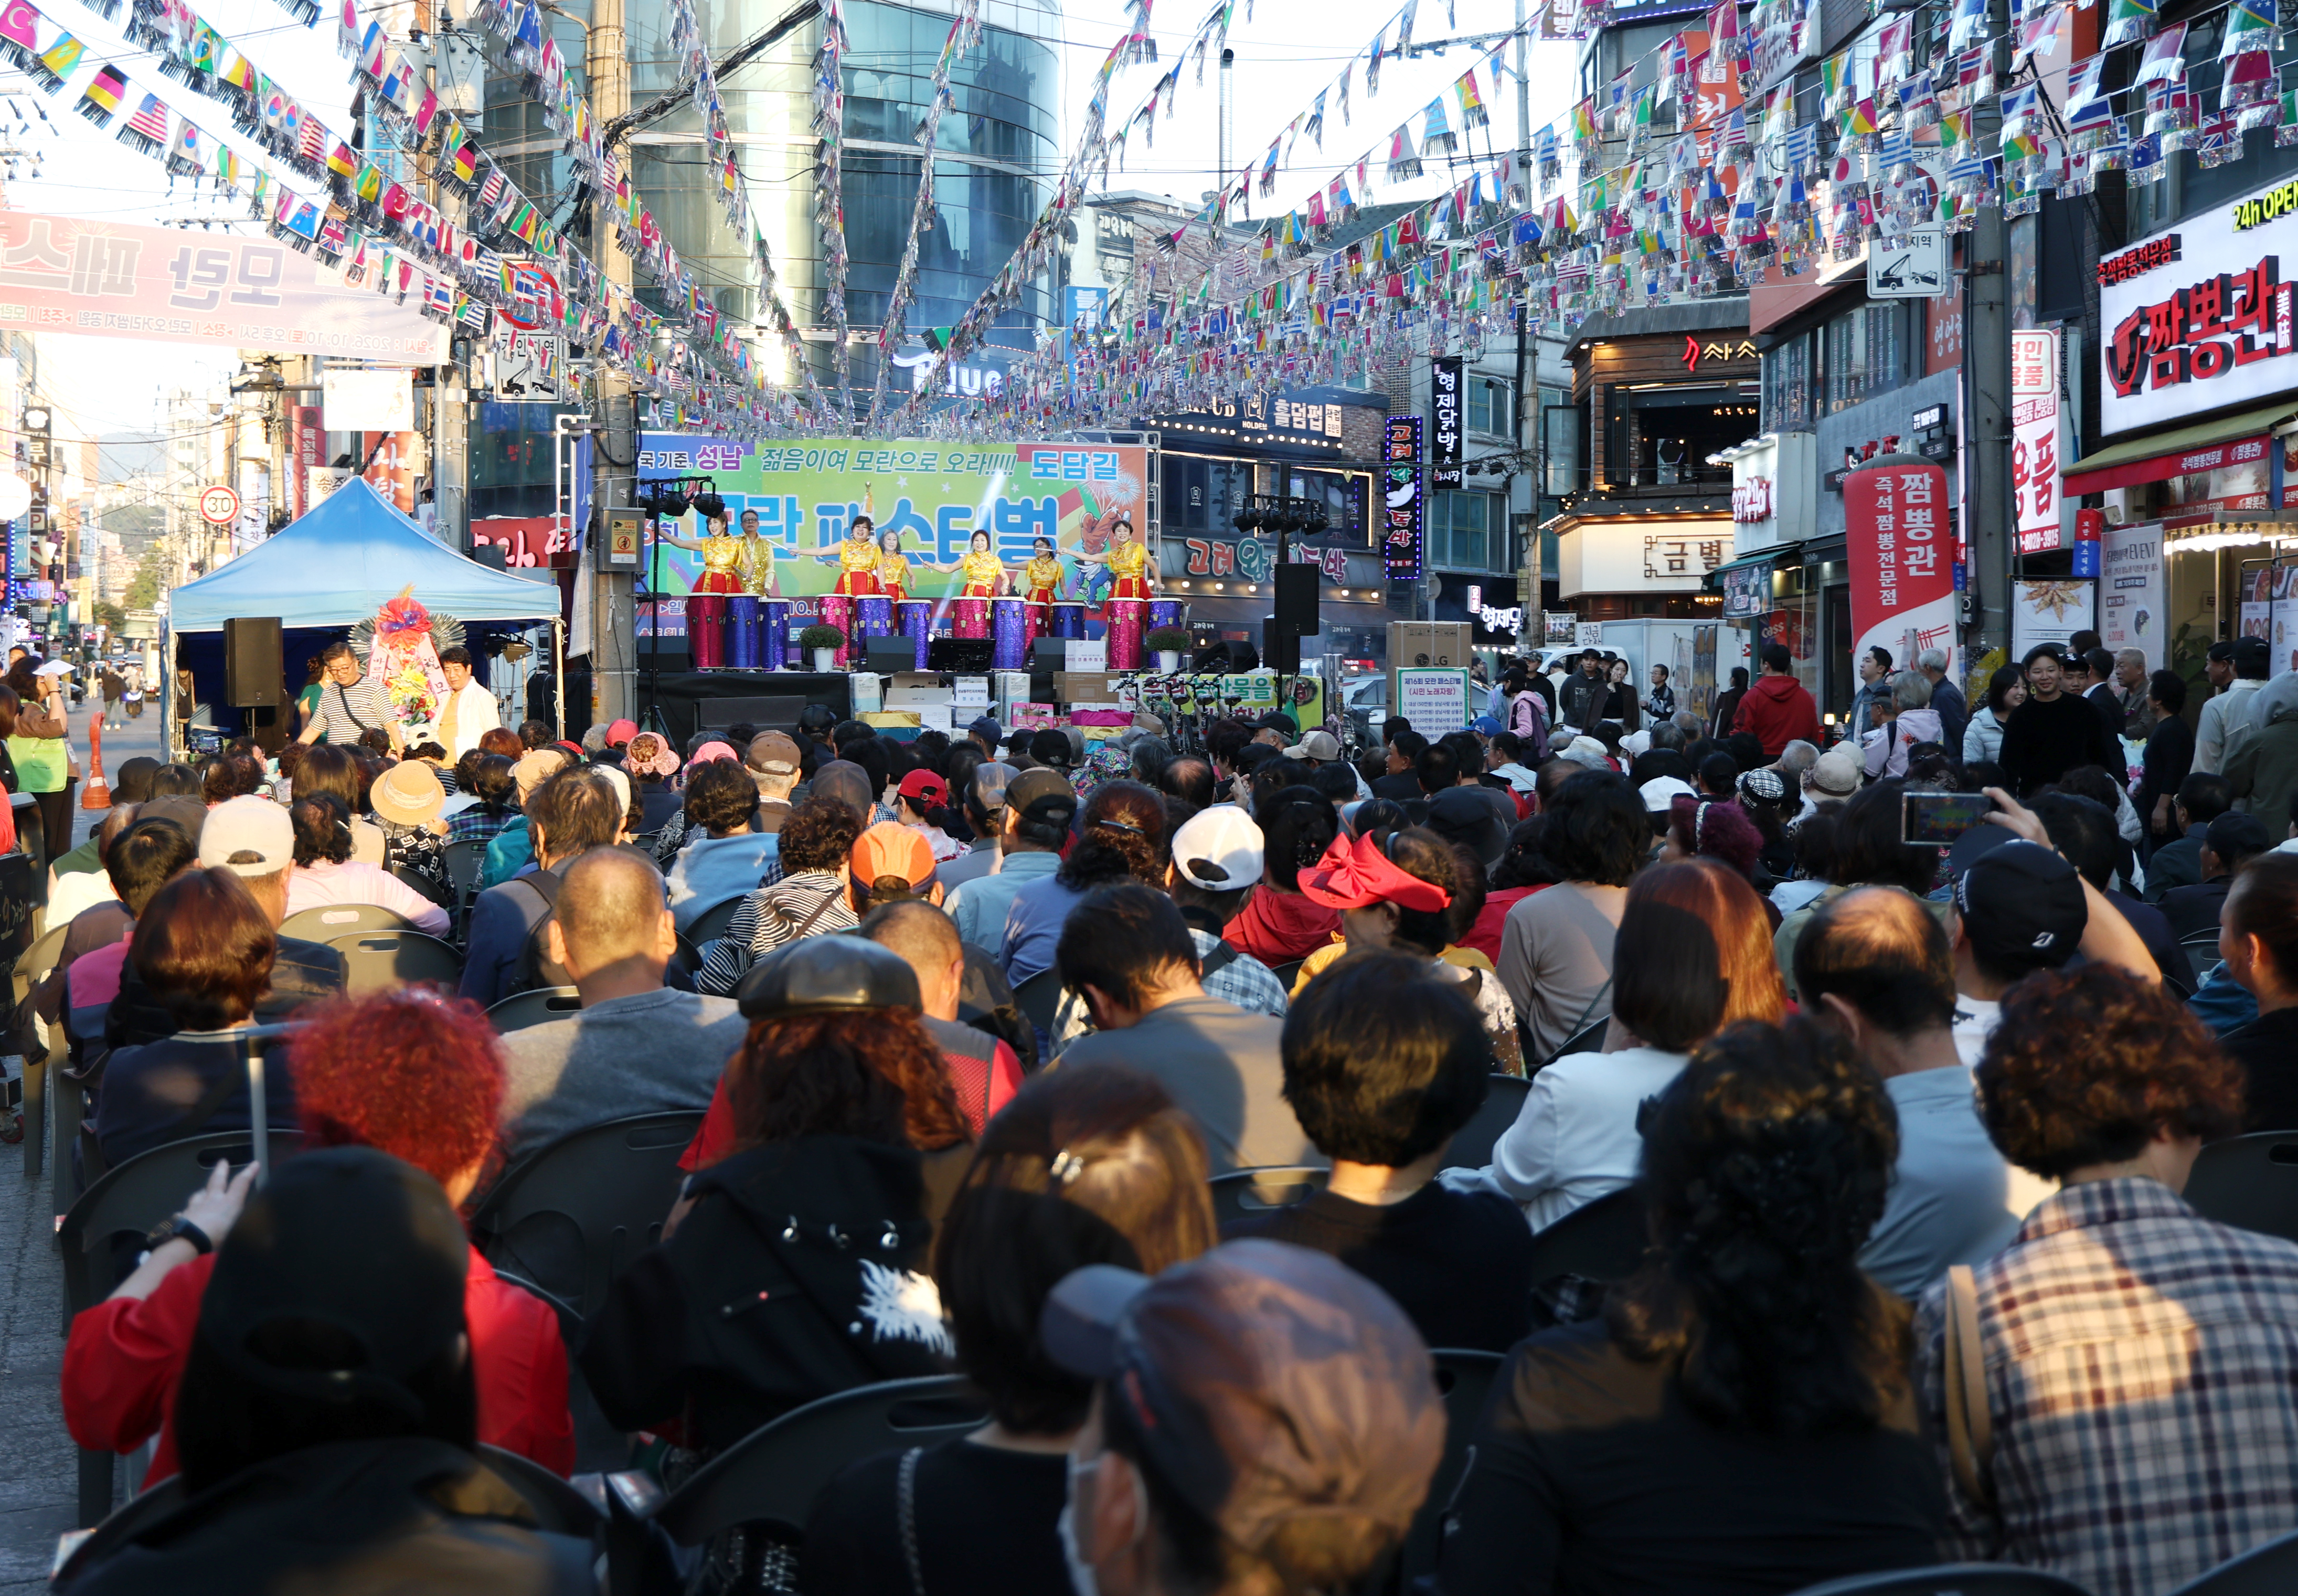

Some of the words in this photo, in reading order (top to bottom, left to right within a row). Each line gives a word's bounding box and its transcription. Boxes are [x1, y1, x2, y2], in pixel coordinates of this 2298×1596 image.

[2232, 200, 2260, 232] 24h
[2145, 256, 2274, 391] 짬뽕관
[1242, 420, 1268, 430] HOLDEM
[1435, 371, 1459, 452] 형제닭발
[659, 451, 693, 469] 기준,
[697, 445, 743, 471] 성남
[762, 448, 849, 472] 젊음이여
[852, 450, 939, 473] 모란으로
[1031, 450, 1119, 482] 도담길
[1389, 425, 1414, 484] 고려왕
[208, 497, 231, 513] 30
[814, 494, 1059, 569] 페스티벌
[1899, 472, 1937, 576] 짬뽕관
[1875, 476, 1897, 606] 즉석짬뽕전문점
[2129, 541, 2156, 560] EVENT
[1184, 536, 1270, 583] 고려왕
[16, 581, 54, 600] 노래방
[1434, 655, 1448, 666] LG
